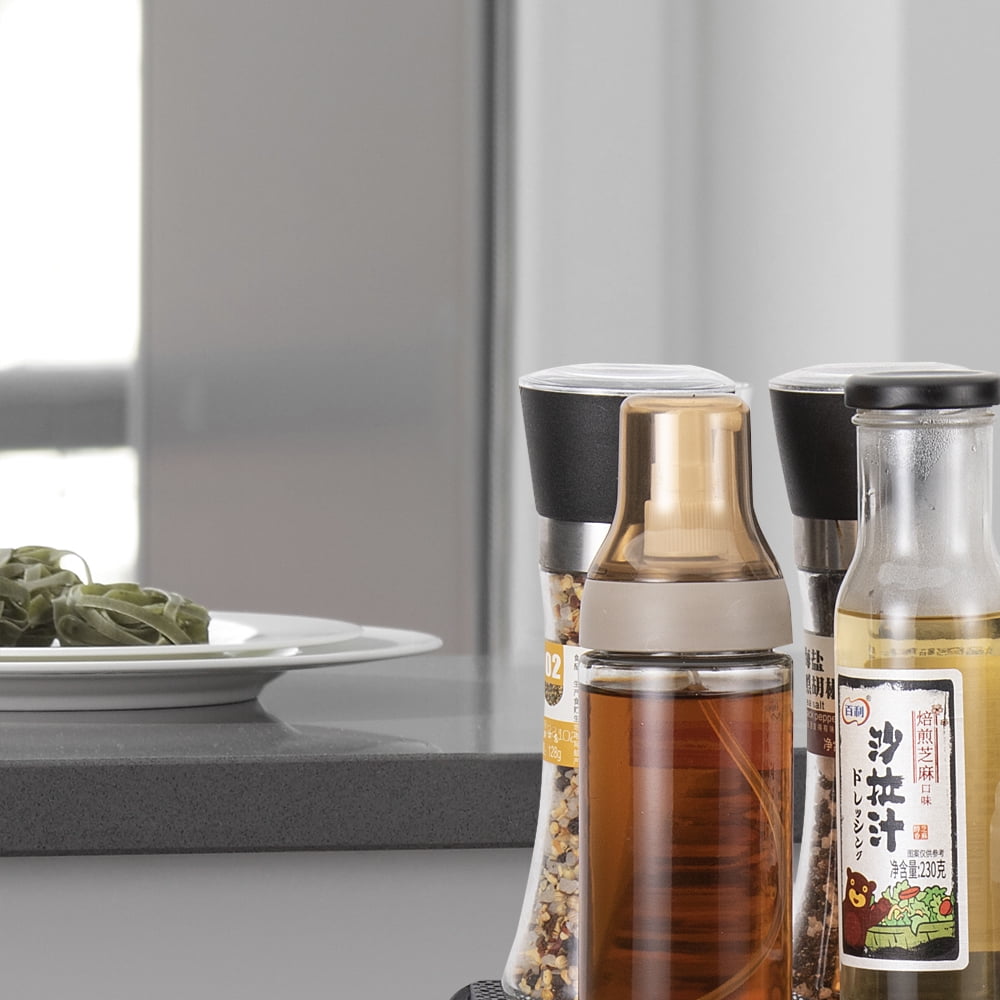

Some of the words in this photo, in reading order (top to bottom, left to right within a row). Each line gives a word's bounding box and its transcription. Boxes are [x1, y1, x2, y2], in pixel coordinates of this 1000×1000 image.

[845, 704, 864, 718] 百利
[853, 767, 864, 861] ドレッシング
[866, 721, 905, 853] 沙拉汁
[890, 859, 946, 879] 净含量:230克
